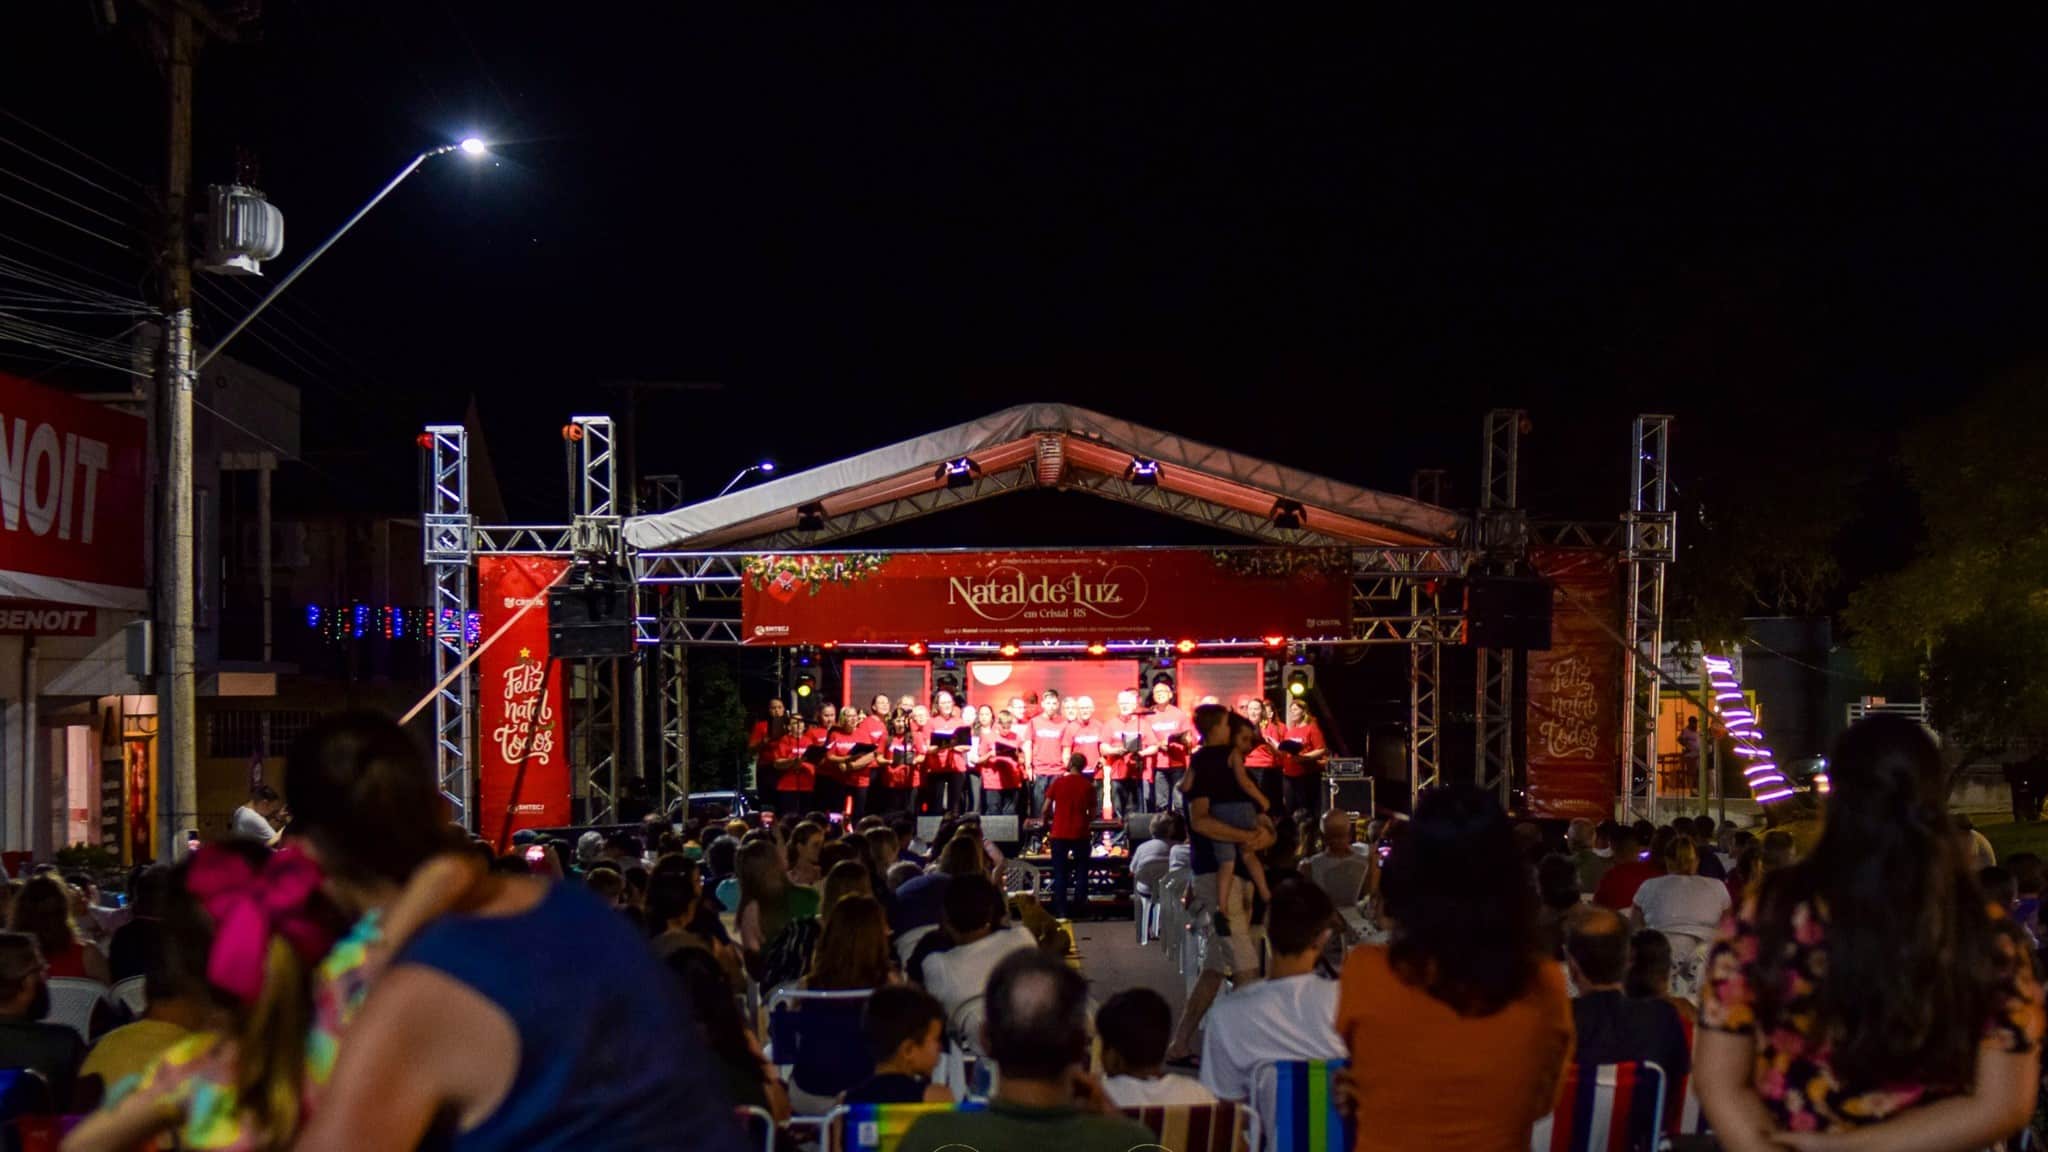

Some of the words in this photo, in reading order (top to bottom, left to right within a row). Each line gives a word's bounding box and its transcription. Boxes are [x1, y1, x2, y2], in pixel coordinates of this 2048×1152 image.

[947, 569, 1028, 615] Natal
[1029, 574, 1067, 604] de
[1066, 570, 1128, 609] Luz
[0, 609, 88, 631] BENOIT
[1023, 610, 1038, 619] em
[1039, 607, 1069, 619] Cristal
[1072, 607, 1087, 618] RS
[503, 660, 545, 700] Feliz
[1550, 656, 1591, 693] Feliz
[494, 724, 555, 766] Toos
